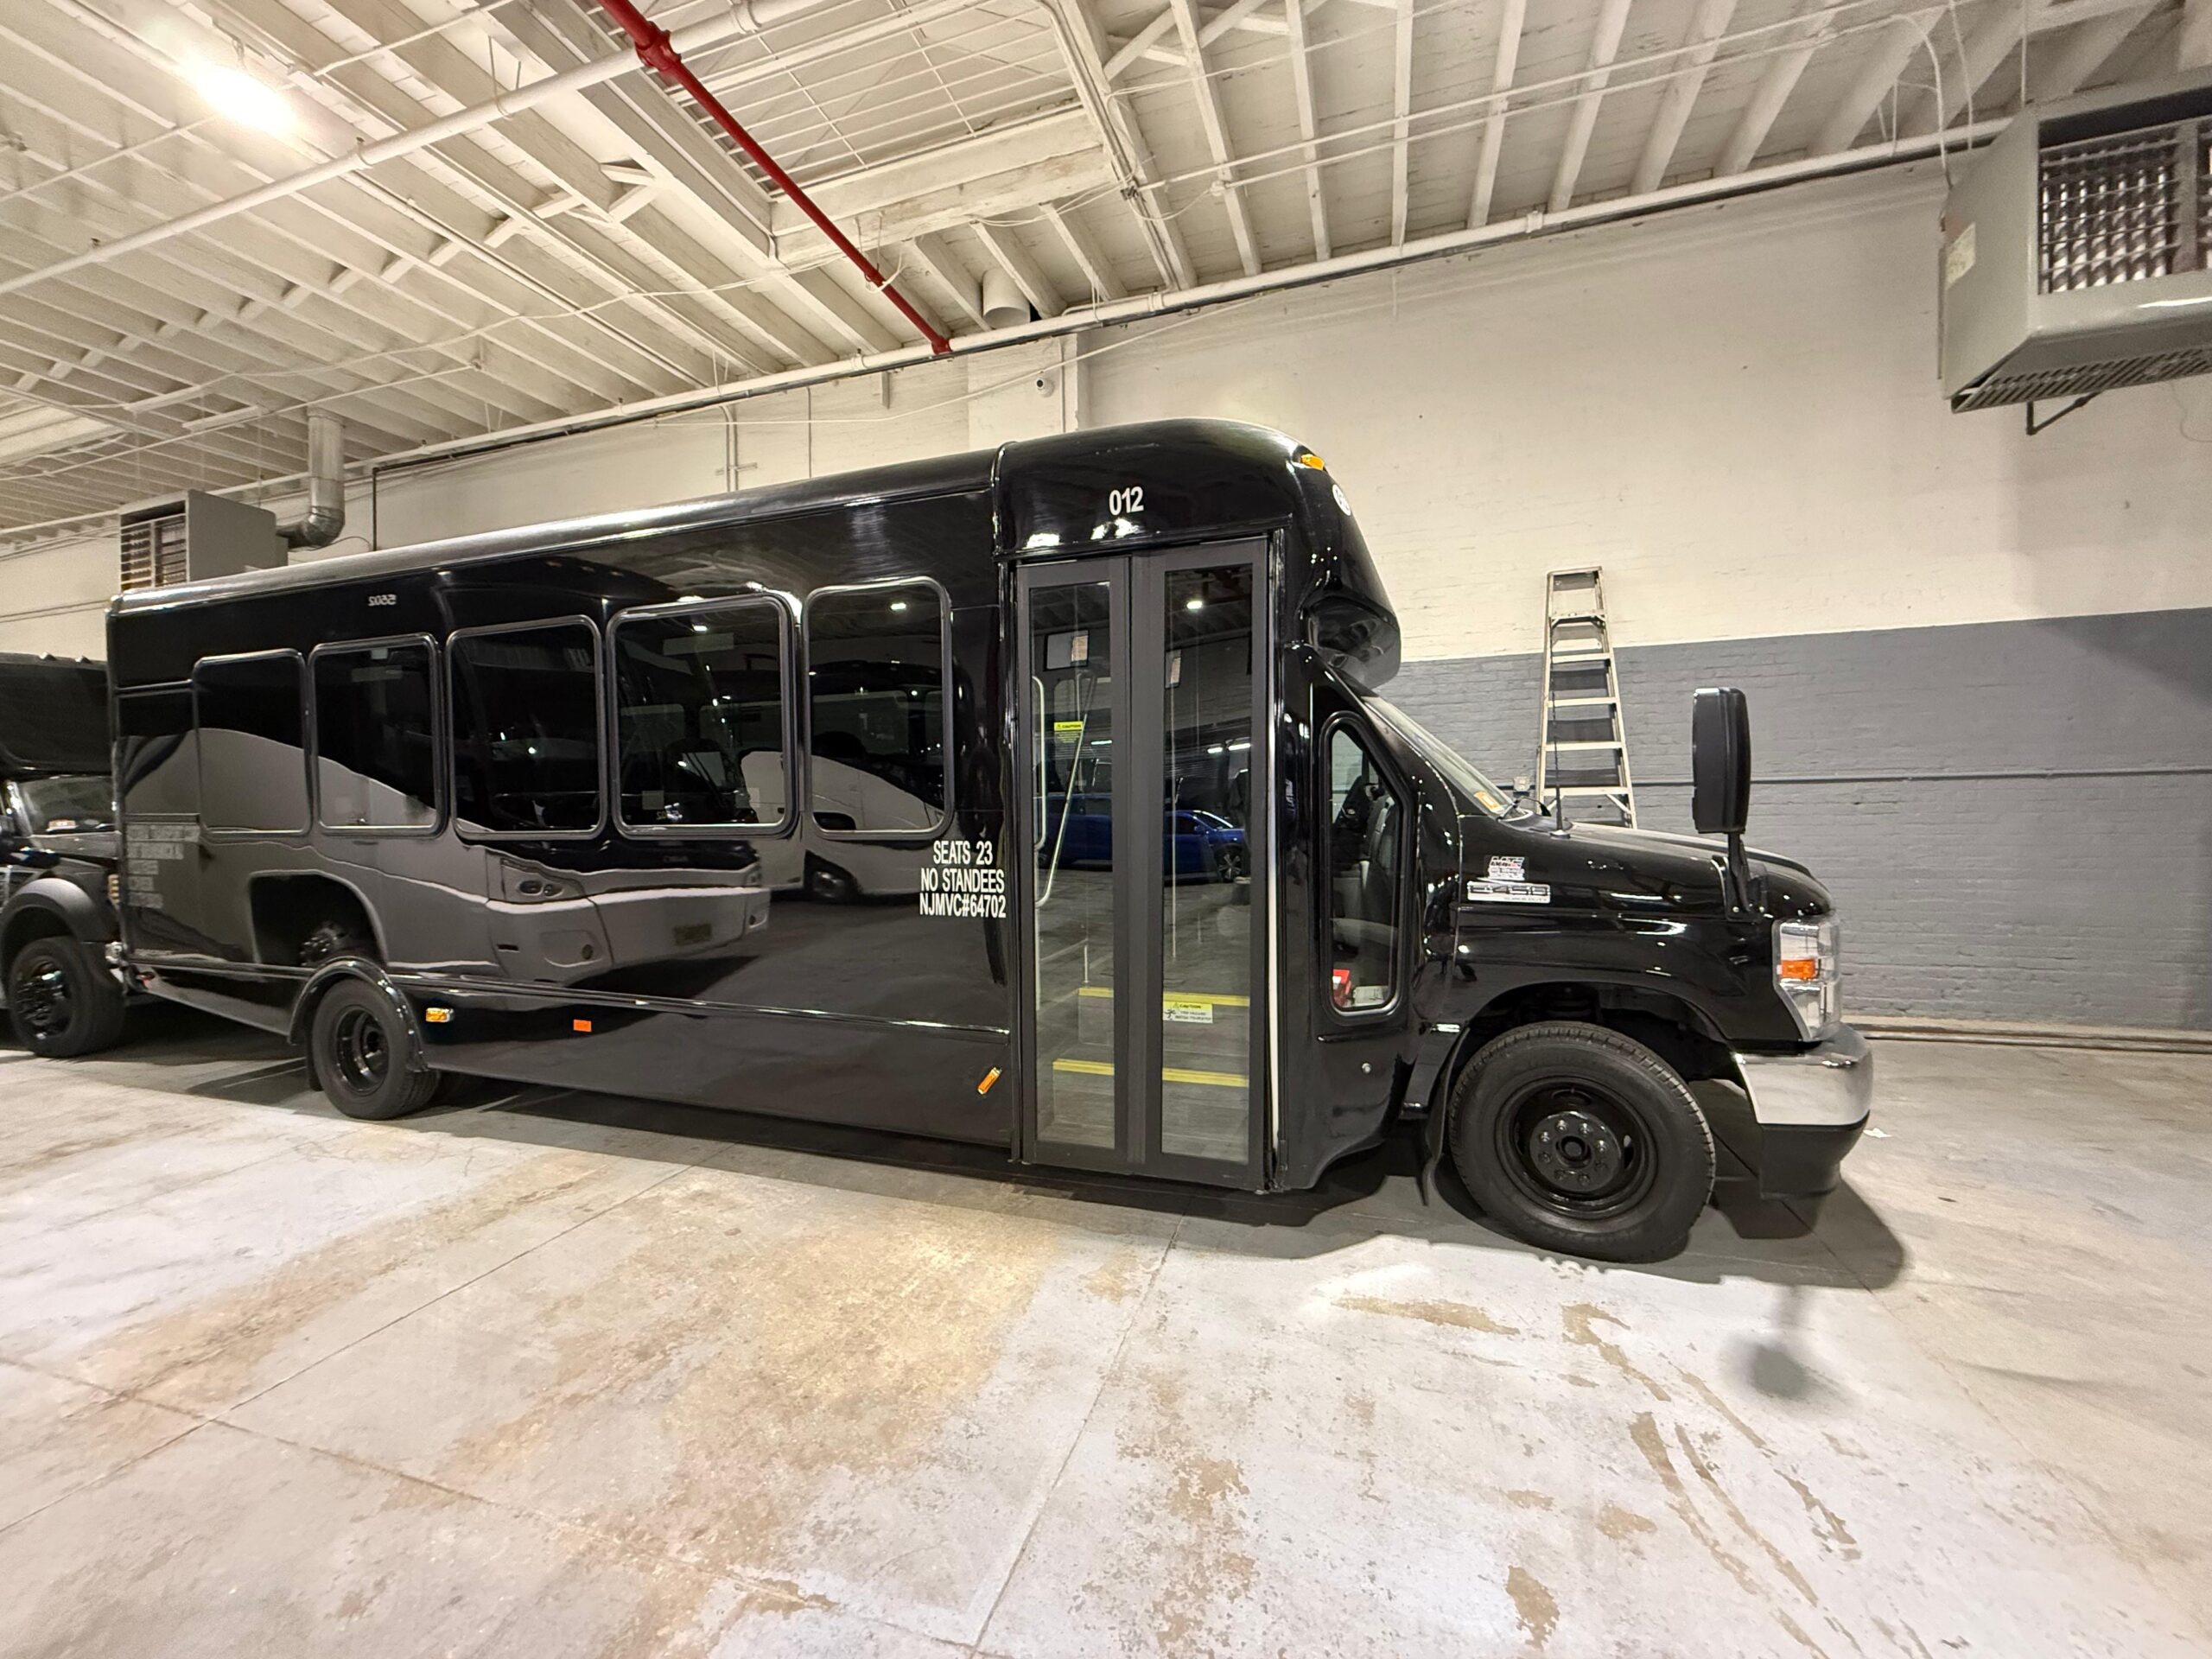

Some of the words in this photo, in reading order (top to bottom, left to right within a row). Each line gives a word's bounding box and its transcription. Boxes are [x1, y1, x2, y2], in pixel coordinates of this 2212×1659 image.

[1109, 486, 1144, 516] 012
[933, 840, 971, 865] SEATS
[976, 840, 993, 866] 23
[920, 868, 939, 892] NO
[942, 868, 1005, 893] STANDEES
[919, 893, 1007, 918] NJMVC#64702
